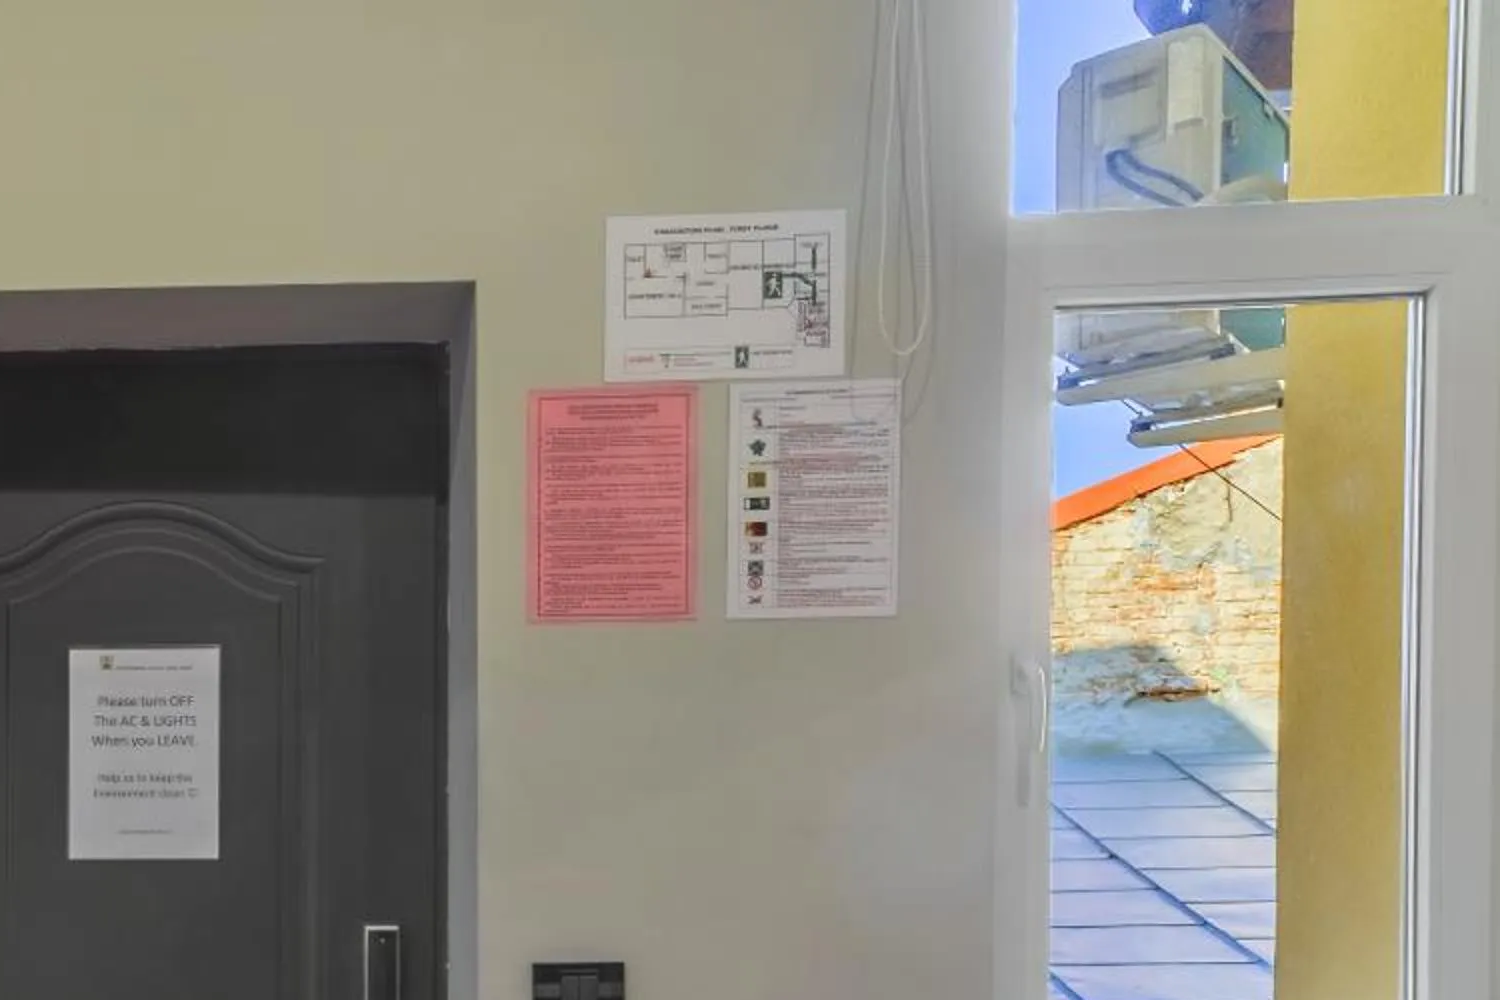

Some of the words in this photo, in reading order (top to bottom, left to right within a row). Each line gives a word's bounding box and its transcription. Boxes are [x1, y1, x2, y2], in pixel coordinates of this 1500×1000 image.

[97, 695, 137, 708] Please
[141, 695, 168, 708] turn
[169, 695, 196, 708] OFF
[94, 715, 118, 727] The
[120, 715, 139, 727] AC
[140, 715, 151, 727] &
[153, 715, 197, 727] LIGHTS
[91, 735, 128, 747] When
[131, 737, 155, 749] you
[157, 735, 195, 747] LEAVE
